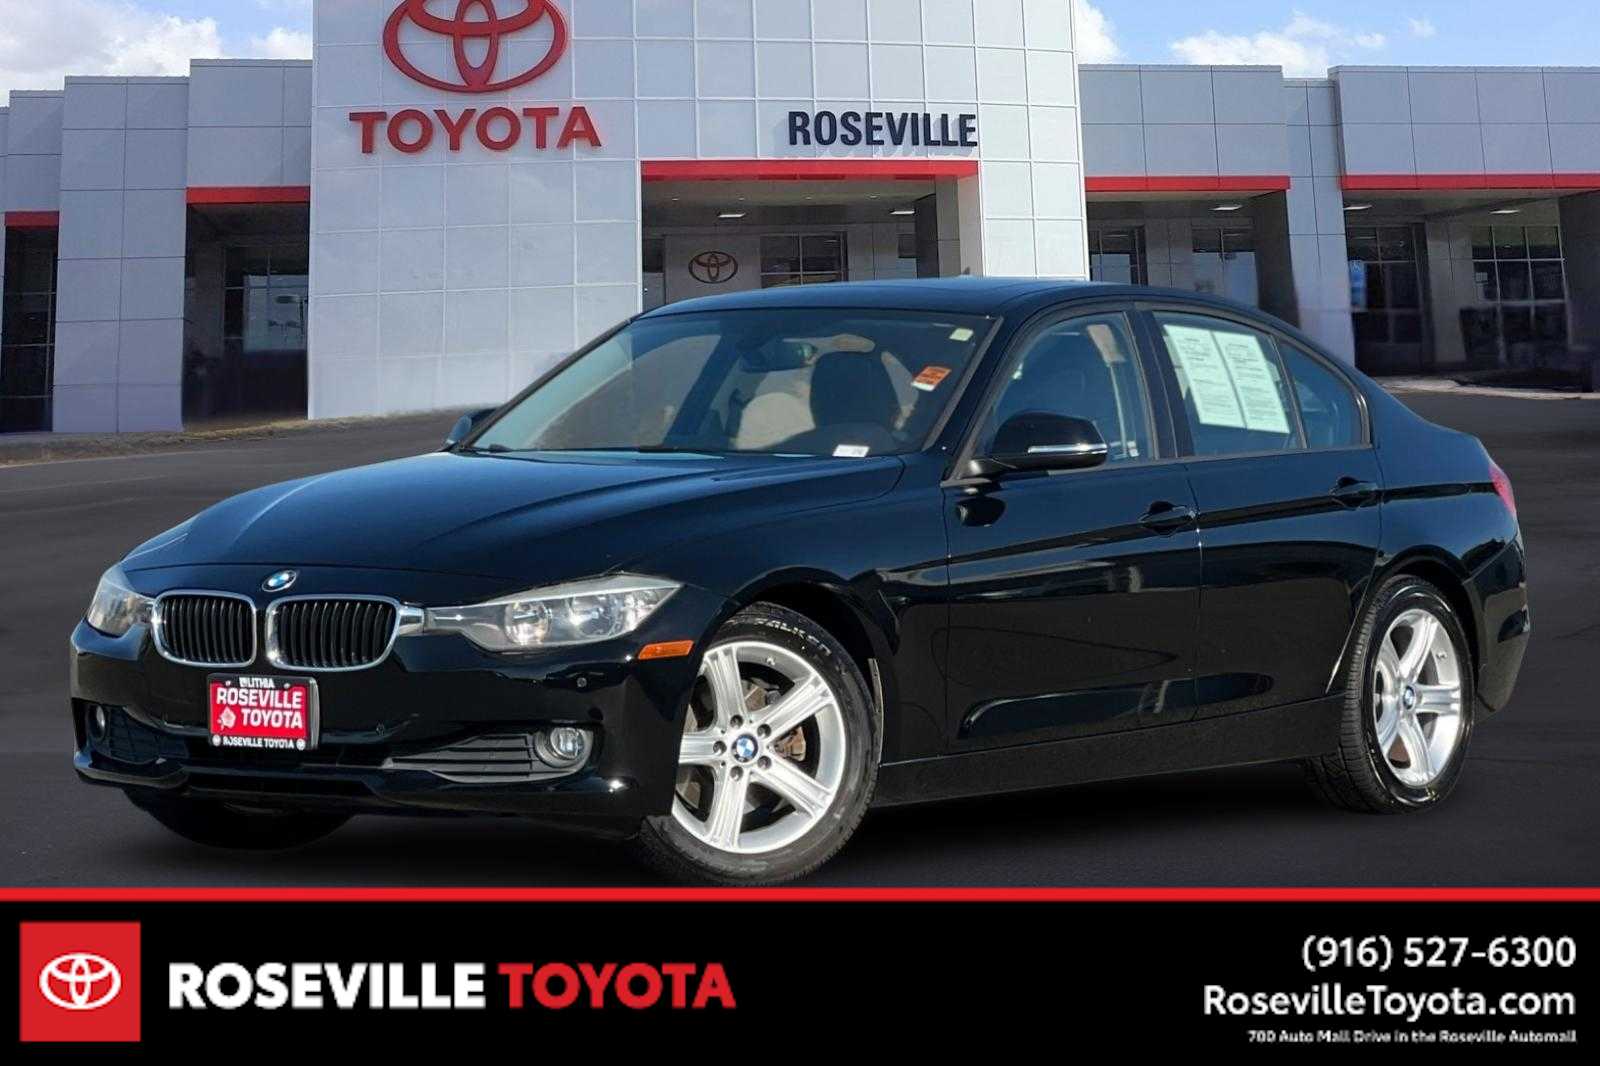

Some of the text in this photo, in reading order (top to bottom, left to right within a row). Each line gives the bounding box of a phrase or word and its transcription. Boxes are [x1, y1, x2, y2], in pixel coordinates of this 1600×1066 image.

[349, 106, 602, 153] TOYOTA
[788, 111, 978, 147] ROSEVILLE
[216, 687, 303, 709] ROSEVILLE
[241, 708, 303, 729] TOYOTA
[223, 736, 294, 750] ROSEVILLE TOYOTA
